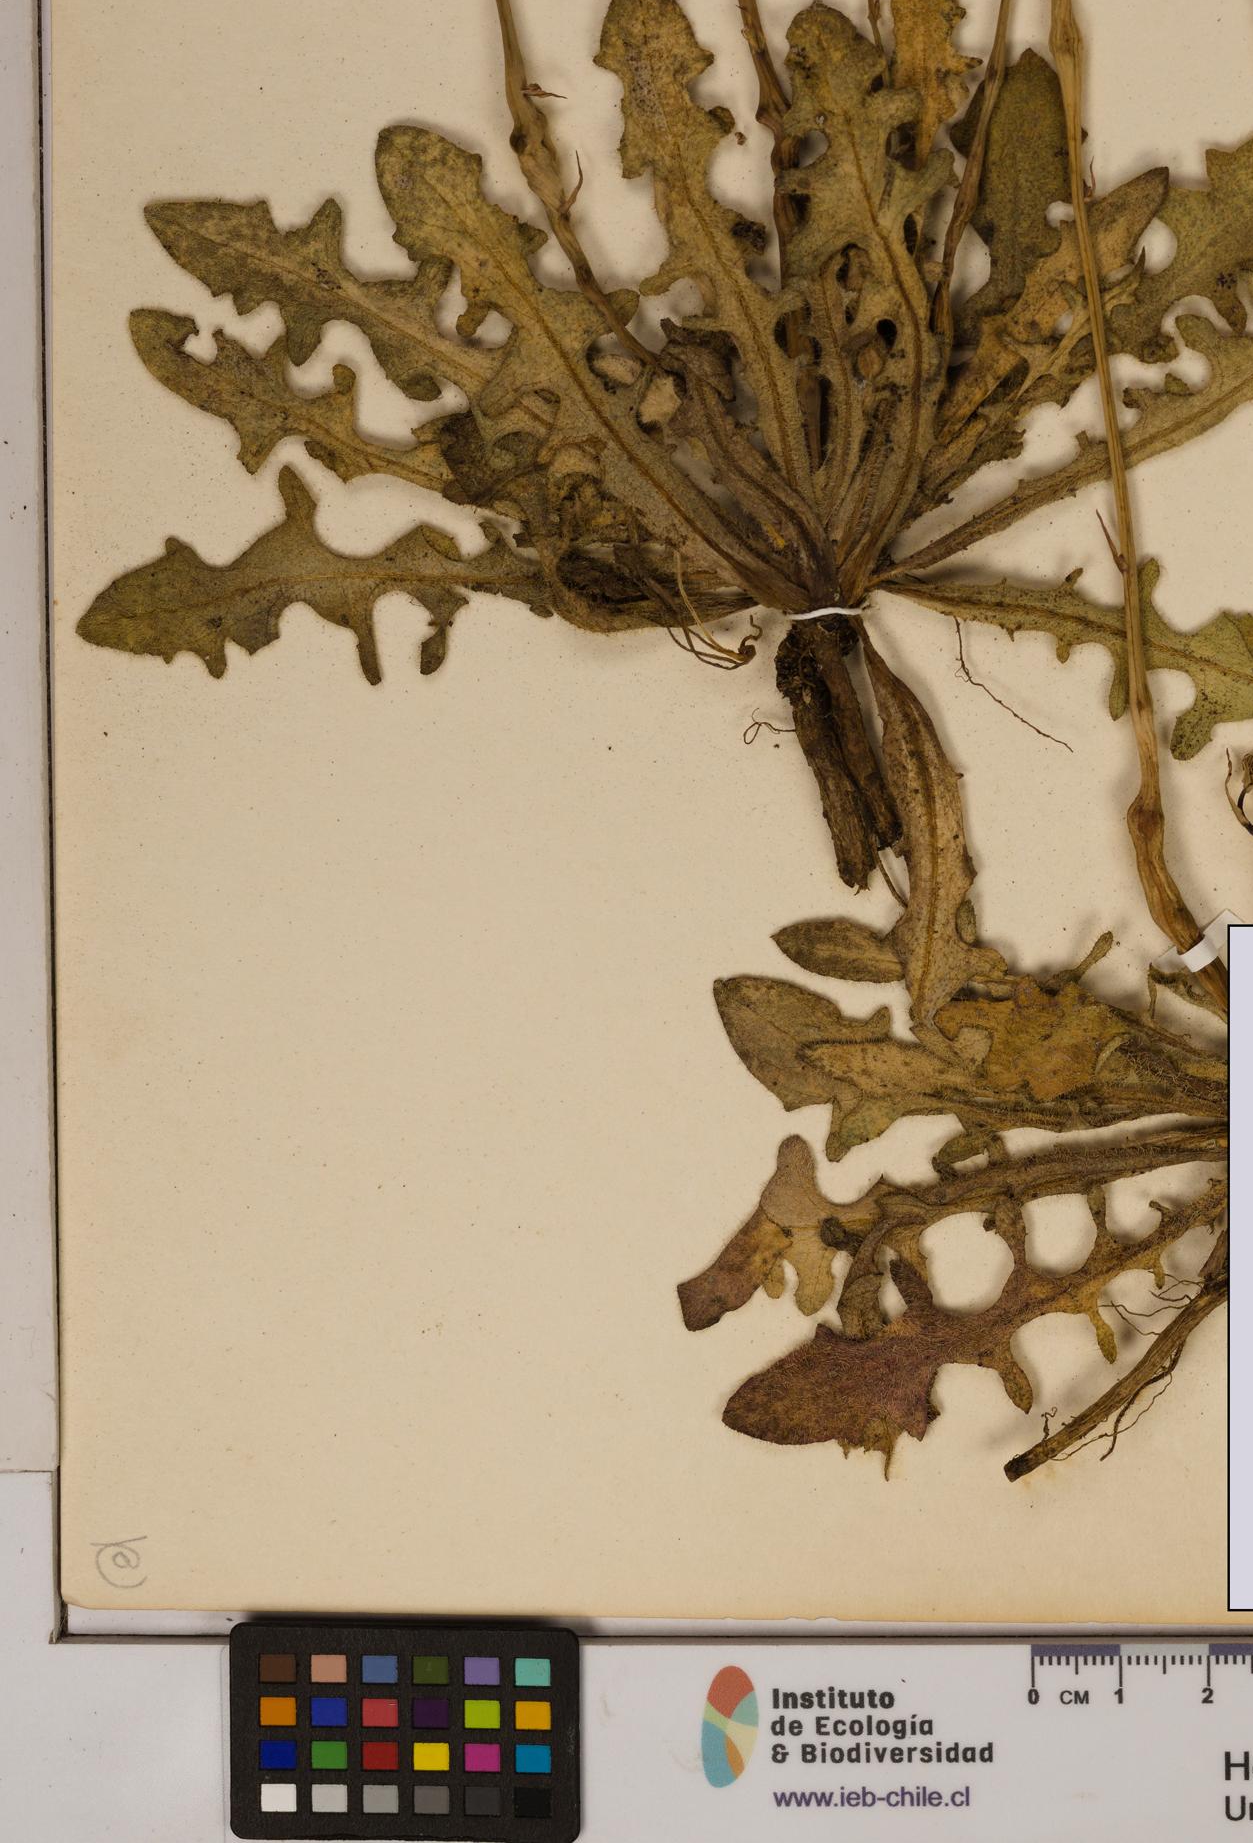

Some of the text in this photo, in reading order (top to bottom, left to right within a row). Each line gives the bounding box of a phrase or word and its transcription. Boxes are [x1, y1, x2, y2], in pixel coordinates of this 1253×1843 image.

[772, 1686, 896, 1710] Instituto
[1027, 1688, 1040, 1705] 0
[1059, 1689, 1090, 1705] CM
[1113, 1687, 1124, 1705] 1
[1201, 1686, 1214, 1704] 2
[770, 1713, 934, 1740] de Ecología
[771, 1741, 994, 1764] & Biodiversidad
[772, 1785, 970, 1808] www.ieb-chile.cl
